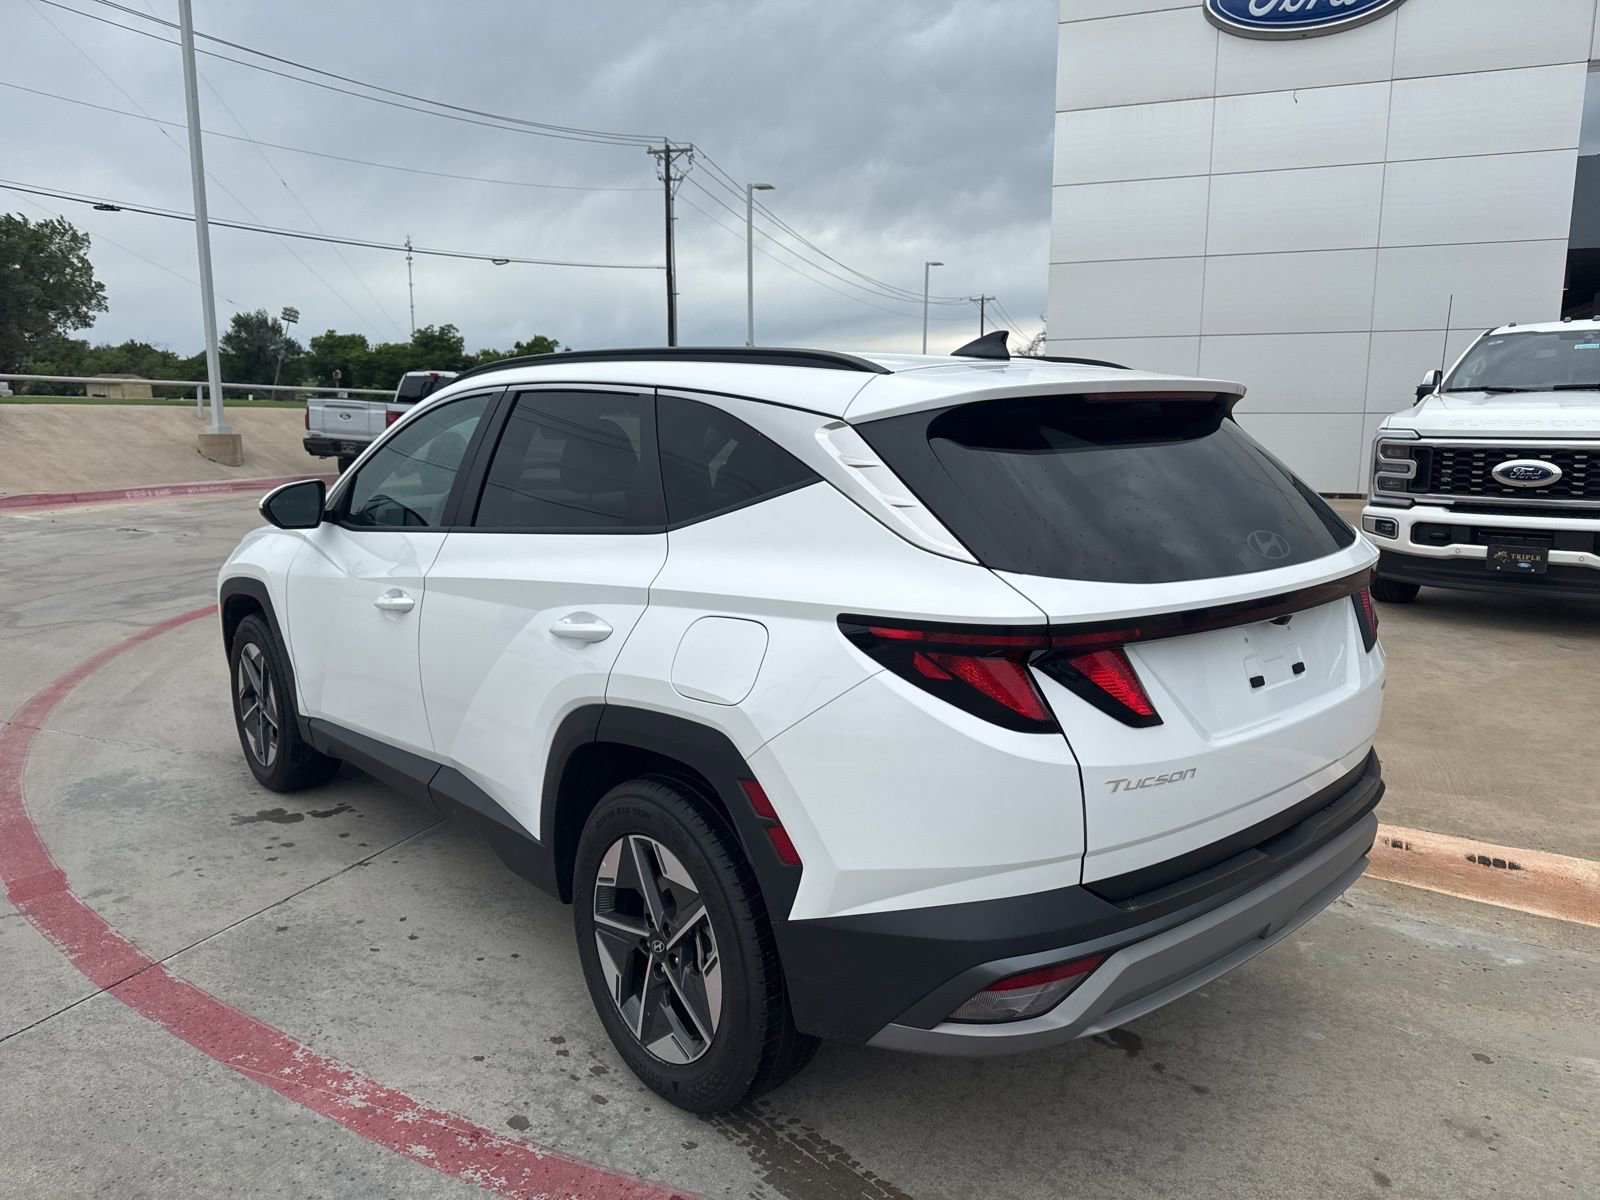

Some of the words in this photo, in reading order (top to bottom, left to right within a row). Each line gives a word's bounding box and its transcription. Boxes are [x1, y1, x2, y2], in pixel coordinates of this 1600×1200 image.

[1248, 0, 1356, 17] or
[1509, 466, 1543, 480] Ford
[1510, 553, 1542, 561] TRIPLE
